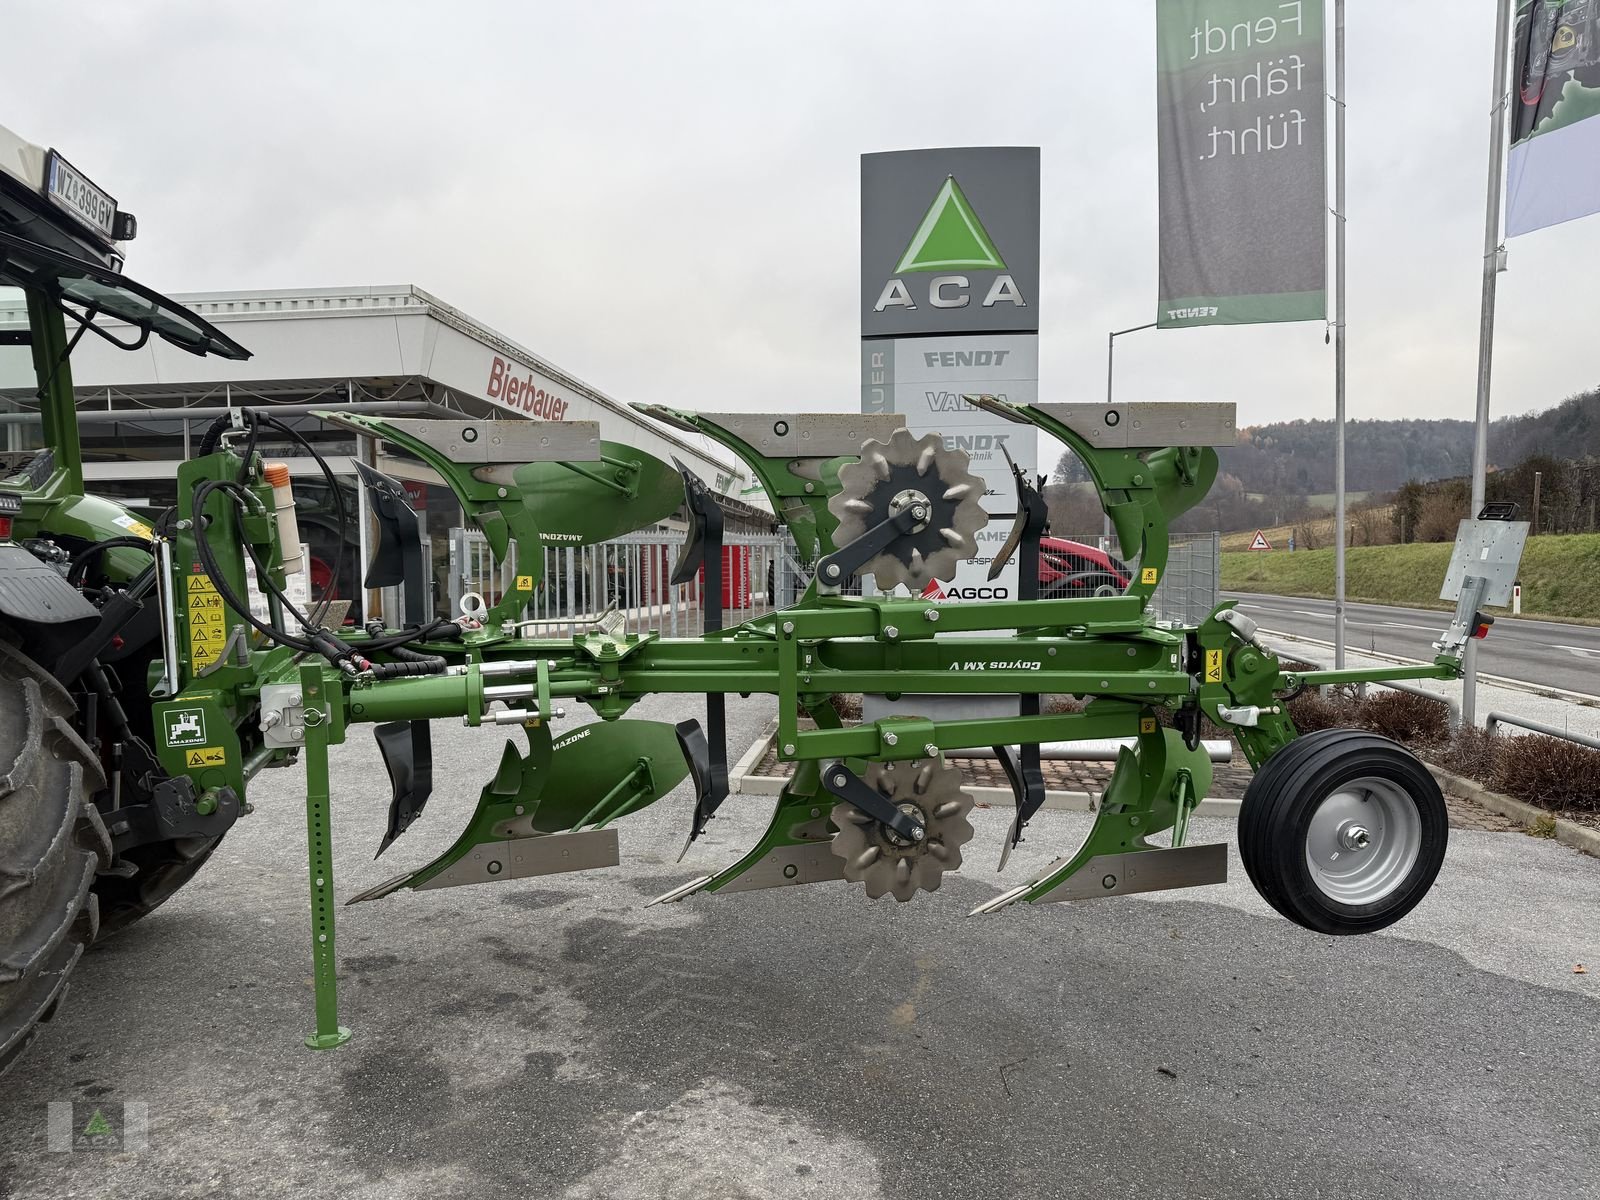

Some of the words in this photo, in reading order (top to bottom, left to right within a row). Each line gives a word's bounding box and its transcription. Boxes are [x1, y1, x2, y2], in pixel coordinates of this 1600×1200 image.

[57, 165, 74, 201] WZ
[78, 184, 98, 220] 399
[872, 274, 1028, 312] ACA
[923, 350, 1011, 368] FENDT
[486, 355, 570, 421] Bierbauer
[942, 434, 1010, 451] ENDT
[947, 587, 1008, 600] AGCO
[949, 661, 959, 671] V
[963, 661, 987, 671] XM
[989, 659, 1041, 671] Cayros
[168, 738, 205, 746] AMAZONE
[552, 728, 591, 752] MAZONE
